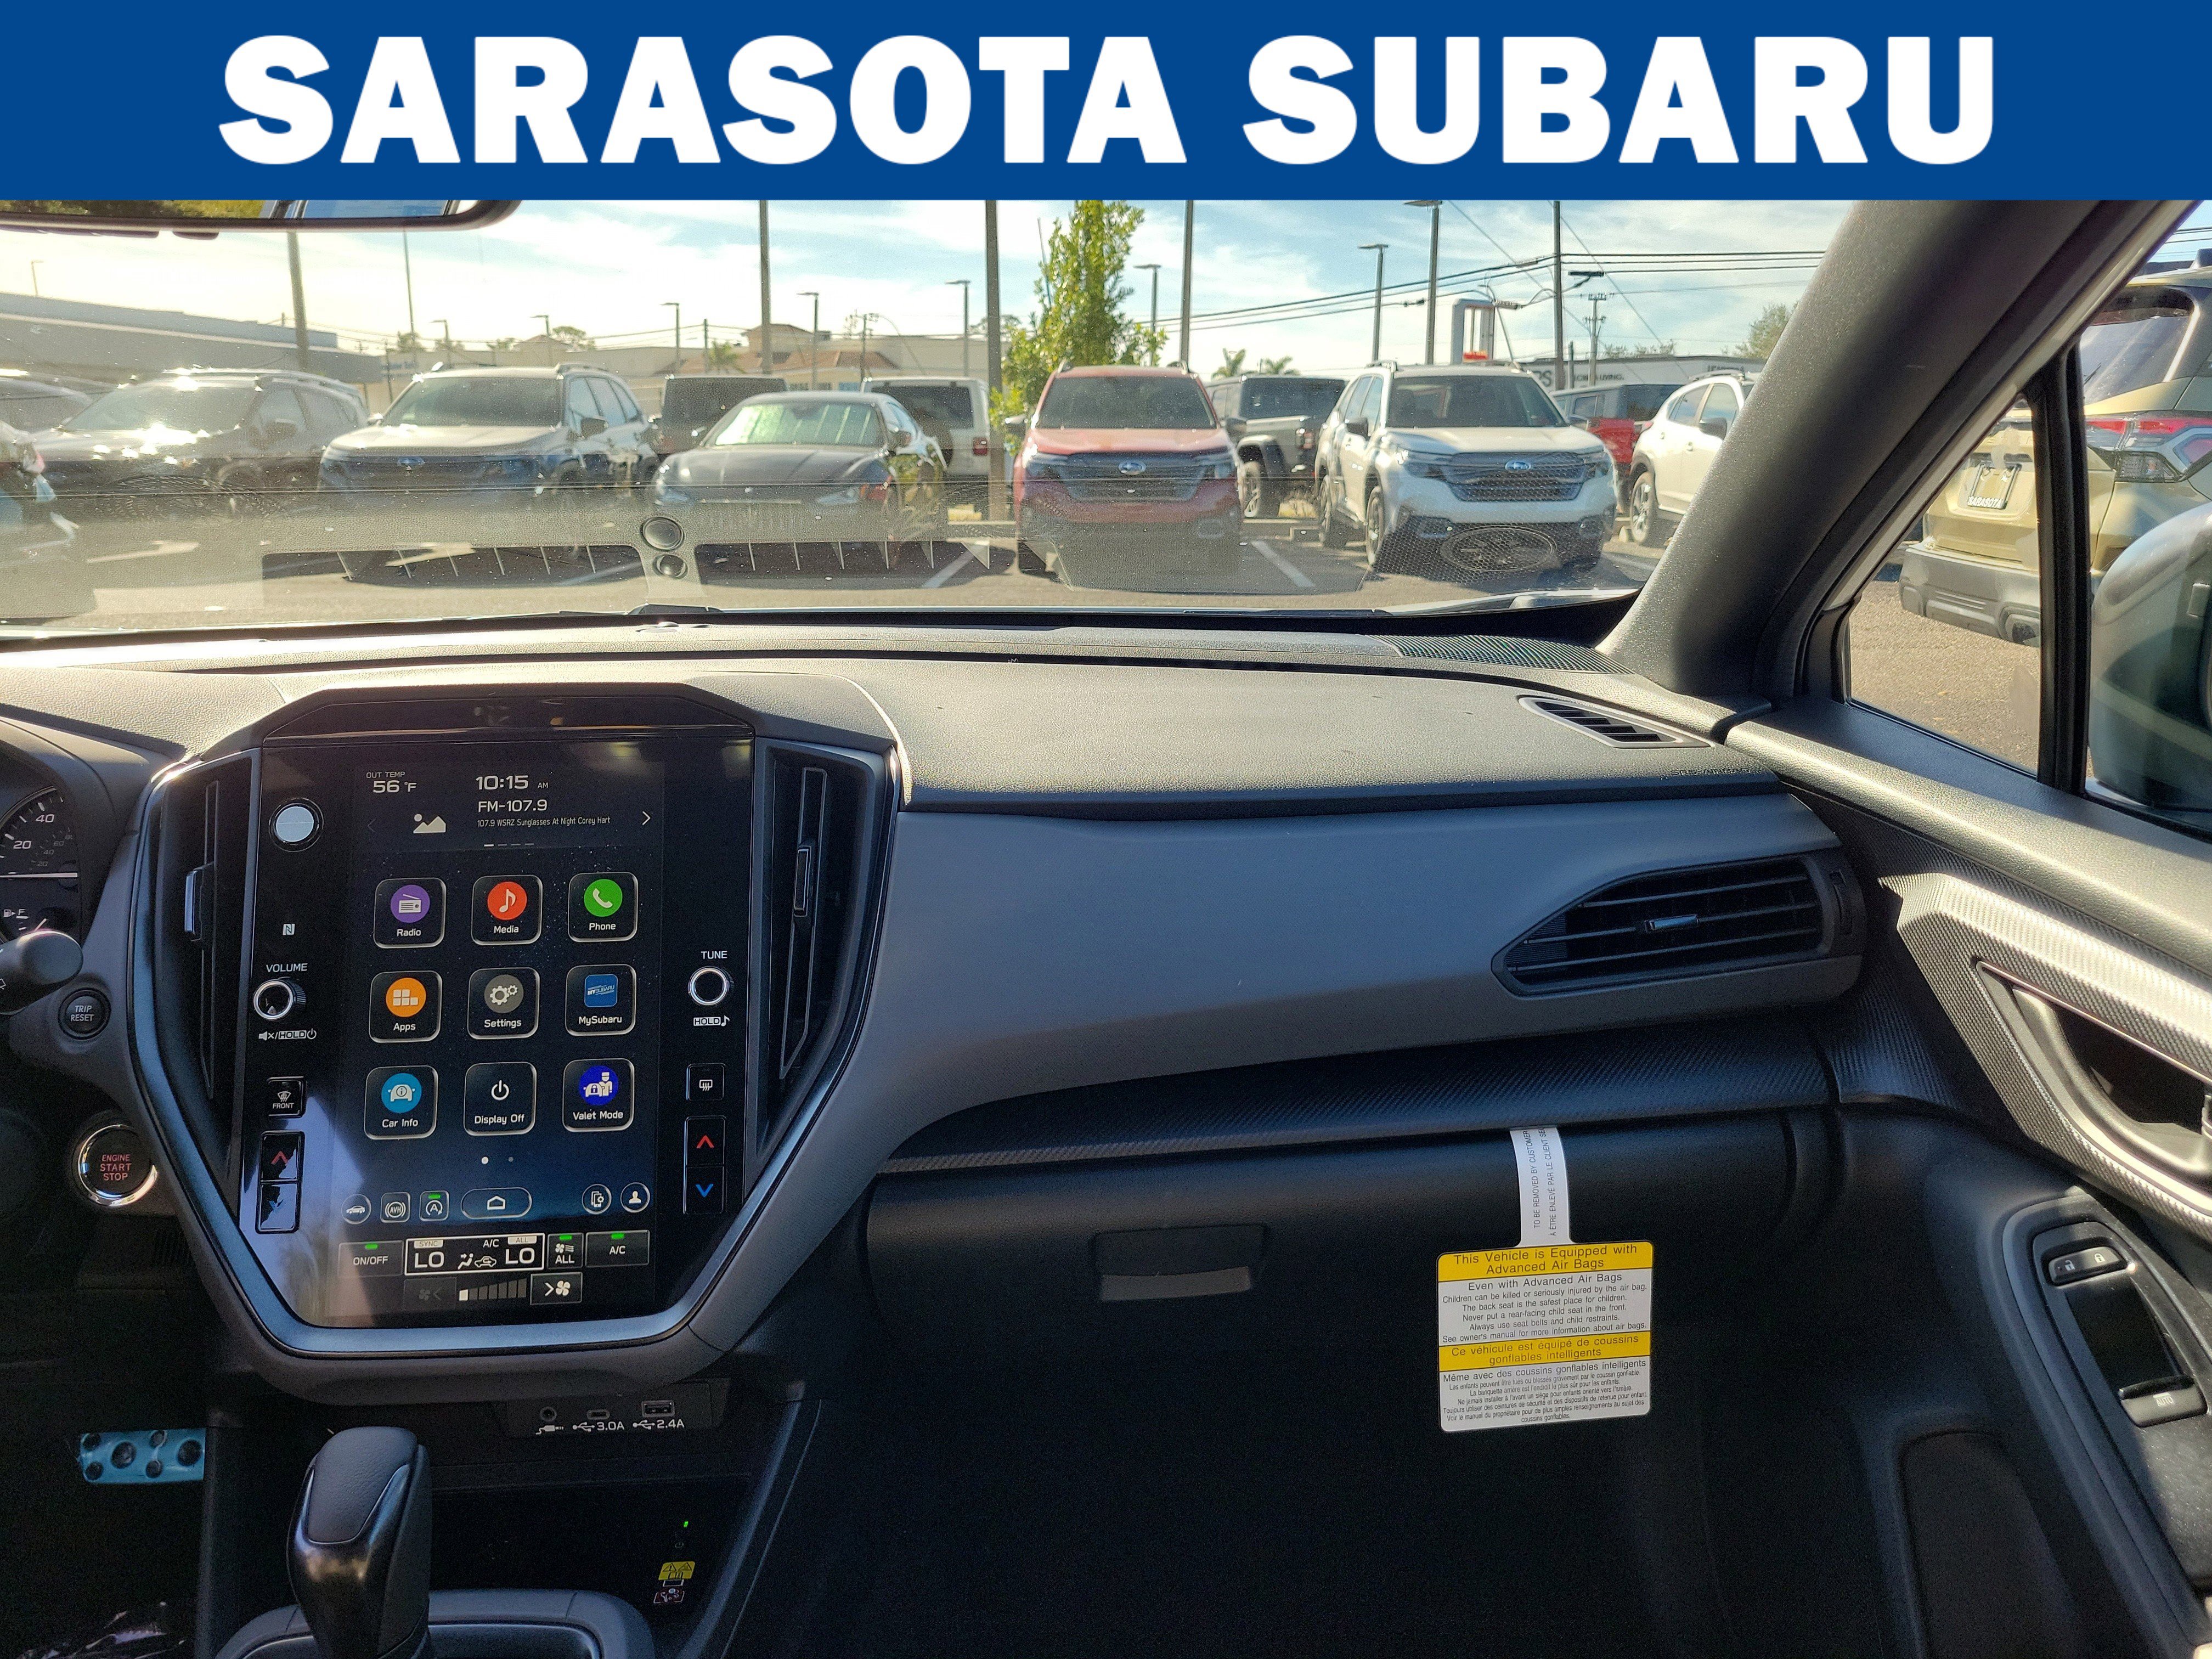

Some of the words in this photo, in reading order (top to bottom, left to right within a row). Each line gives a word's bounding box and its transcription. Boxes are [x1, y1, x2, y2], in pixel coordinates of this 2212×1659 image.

[1968, 496, 2003, 508] SARASOTA
[374, 780, 399, 793] 56
[476, 776, 528, 789] 10:15
[478, 799, 547, 812] FM-107.9
[36, 814, 54, 822] 40
[517, 819, 550, 827] Sunglasses
[561, 817, 575, 826] Night
[578, 817, 595, 825] Corey
[13, 840, 31, 850] 20
[701, 951, 727, 959] TUNE
[266, 963, 307, 972] VOLUME
[70, 1013, 94, 1022] RESET
[579, 1016, 622, 1025] MySubaru
[393, 1023, 415, 1032] Apps
[484, 1019, 521, 1028] Settings
[475, 1115, 506, 1125] Display
[511, 1114, 524, 1122] Off
[573, 1110, 596, 1120] Valet
[382, 1119, 398, 1127] Car
[1522, 1130, 1536, 1163] CUSTOMER
[1541, 1139, 1552, 1160] CLIENT
[100, 1164, 131, 1174] START
[1530, 1165, 1537, 1173] BY
[1547, 1161, 1553, 1170] LE
[1531, 1176, 1540, 1207] REMOVED
[1547, 1187, 1556, 1211] ENLEVÉ
[390, 1205, 402, 1215] AVH
[1533, 1209, 1541, 1217] BE
[1533, 1220, 1541, 1228] TO
[483, 1238, 499, 1248] A/C
[610, 1246, 625, 1254] A/C
[1454, 1254, 1479, 1265] This
[1485, 1250, 1529, 1262] Vehicle
[1535, 1249, 1544, 1259] is
[1550, 1245, 1607, 1260] Equipped
[1613, 1242, 1637, 1254] with
[353, 1255, 388, 1266] ON/OFF
[415, 1252, 444, 1268] LO
[506, 1248, 534, 1264] LO
[555, 1255, 574, 1263] ALL
[1486, 1262, 1545, 1274] Advanced
[1551, 1260, 1568, 1271] Air
[1574, 1259, 1604, 1270] Bags
[1469, 1282, 1493, 1291] Even
[1498, 1279, 1518, 1289] with
[1523, 1276, 1573, 1287] Advanced
[1578, 1274, 1592, 1283] Air
[1597, 1273, 1622, 1283] Bags
[1443, 1295, 1472, 1304] Children
[1503, 1291, 1521, 1299] killed
[1534, 1288, 1565, 1297] seriously
[1568, 1286, 1592, 1296] injured
[1594, 1285, 1603, 1295] by
[1632, 1284, 1647, 1292] bag.
[1479, 1302, 1496, 1311] back
[1564, 1297, 1583, 1306] place
[1598, 1294, 1627, 1302] children.
[1487, 1313, 1498, 1322] put
[1508, 1310, 1546, 1318] rear-facing
[1548, 1307, 1565, 1316] child
[1469, 1323, 1494, 1331] Always
[1586, 1314, 1620, 1323] restraints.
[1459, 1334, 1487, 1342] owner's
[1490, 1330, 1516, 1339] manual
[1552, 1326, 1590, 1335] information
[1593, 1324, 1613, 1332] about
[1452, 1347, 1466, 1356] Ce
[1471, 1344, 1513, 1355] véhicule
[1518, 1342, 1533, 1351] est
[1538, 1339, 1572, 1351] équipé
[1577, 1338, 1590, 1347] de
[1594, 1335, 1639, 1345] coussins
[1489, 1353, 1542, 1366] gonflables
[1547, 1348, 1601, 1359] intelligents
[1443, 1374, 1470, 1383] Même
[1497, 1370, 1512, 1378] des
[1516, 1367, 1553, 1376] coussins
[1556, 1363, 1599, 1375] gonflables
[1602, 1360, 1646, 1370] intelligents
[2155, 1396, 2174, 1406] AUTO
[1544, 1413, 1570, 1422] gonflables.
[597, 1421, 624, 1430] 3.0A
[657, 1419, 684, 1428] 2.4A
